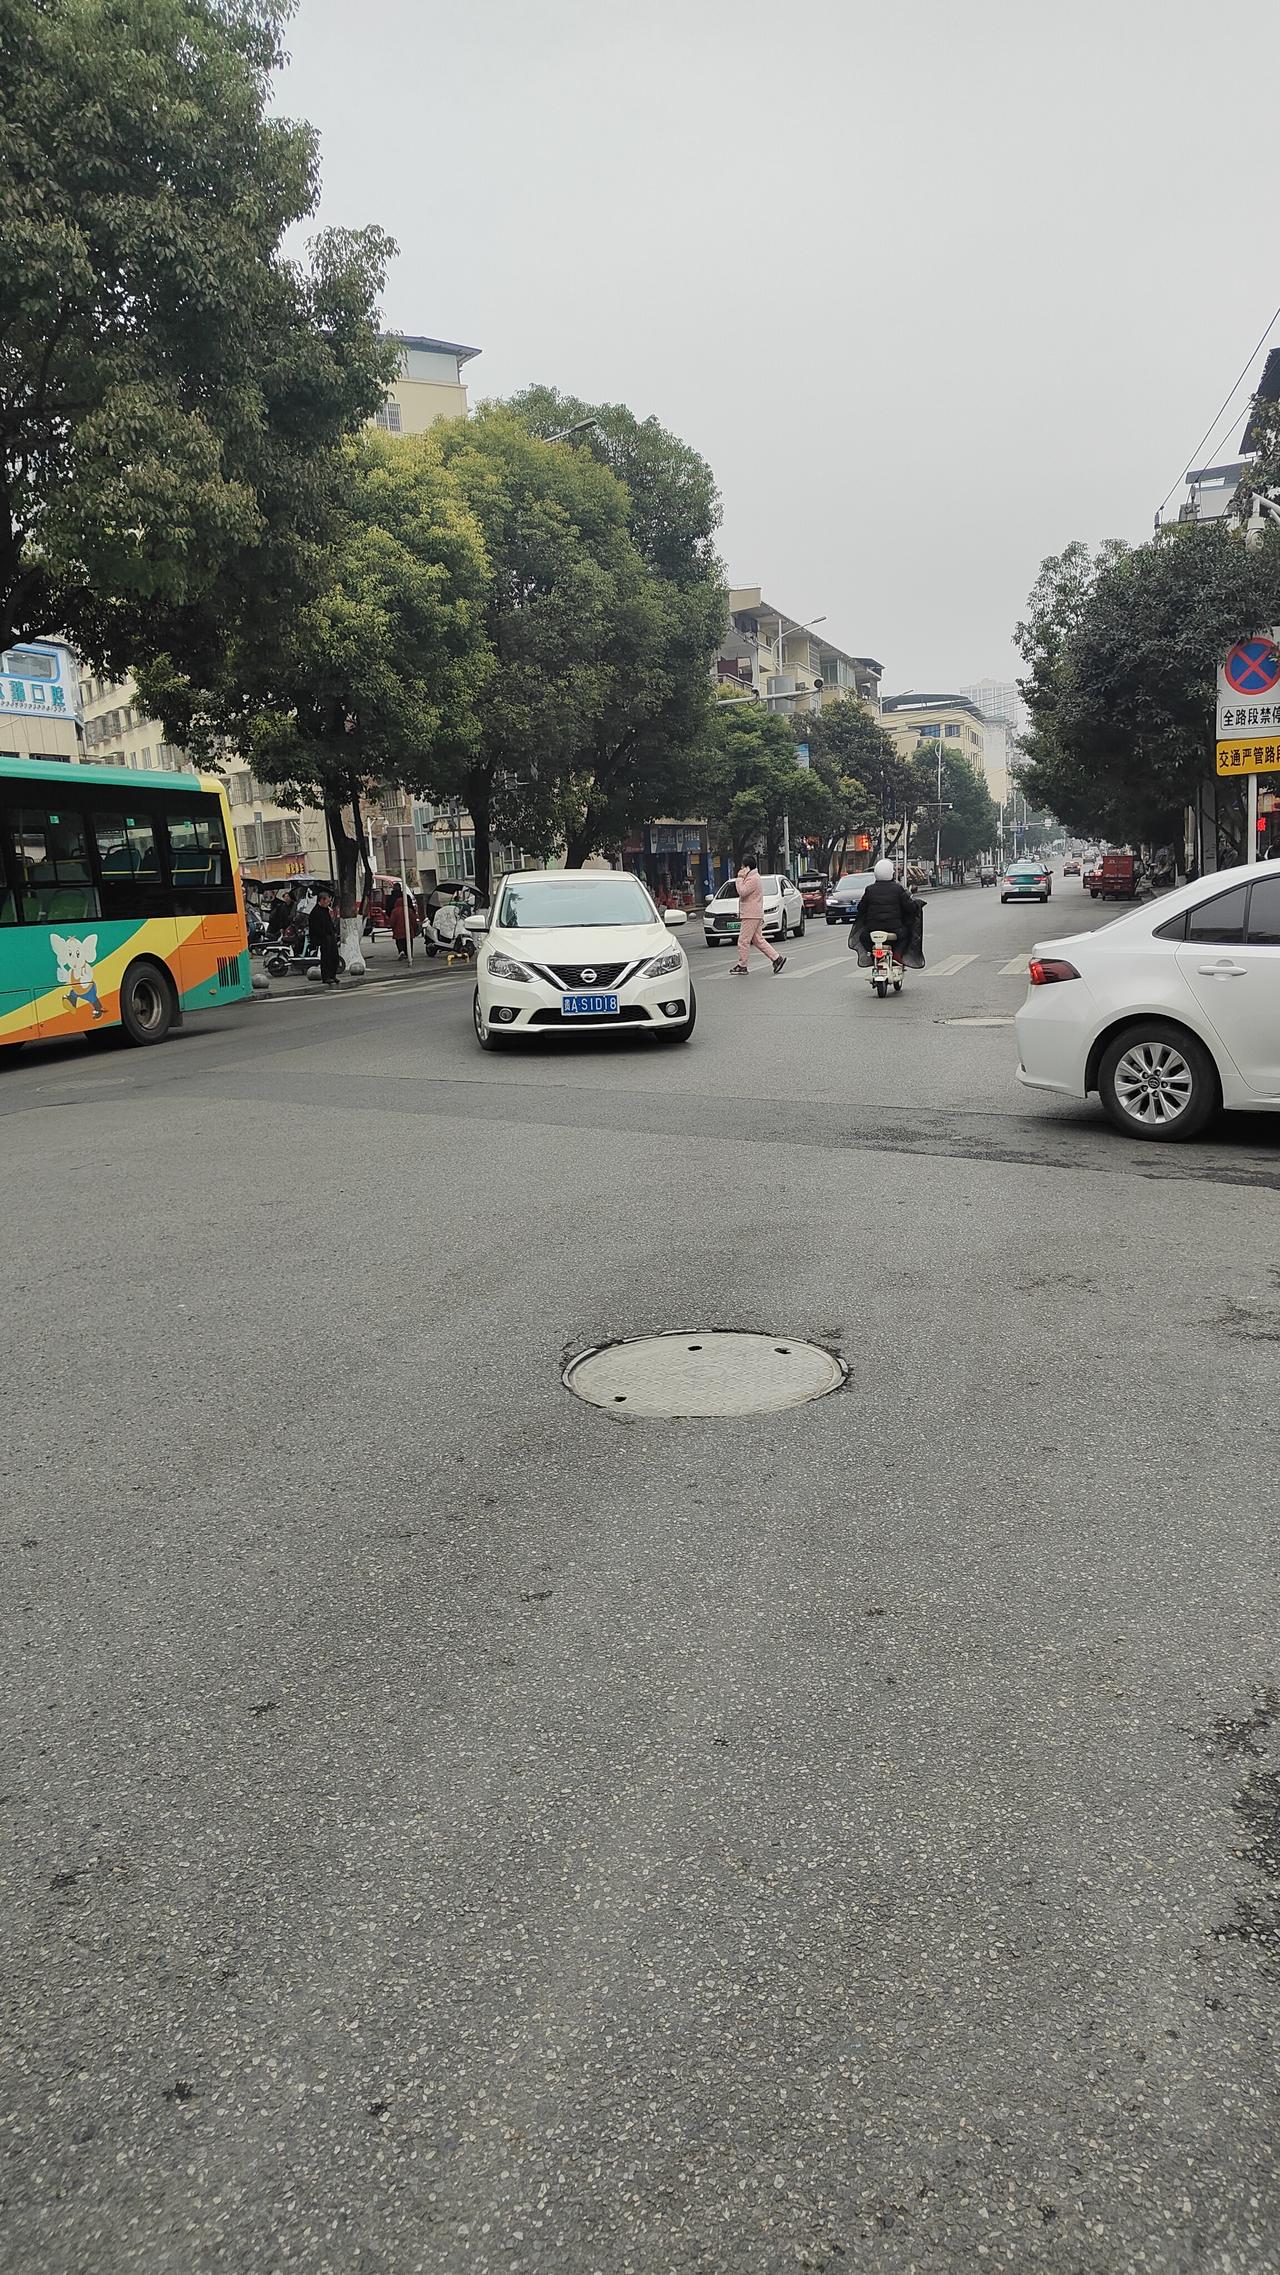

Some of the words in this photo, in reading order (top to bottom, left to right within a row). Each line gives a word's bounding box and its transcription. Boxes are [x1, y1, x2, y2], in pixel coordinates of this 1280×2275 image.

[1223, 706, 1280, 726] 全路段禁停
